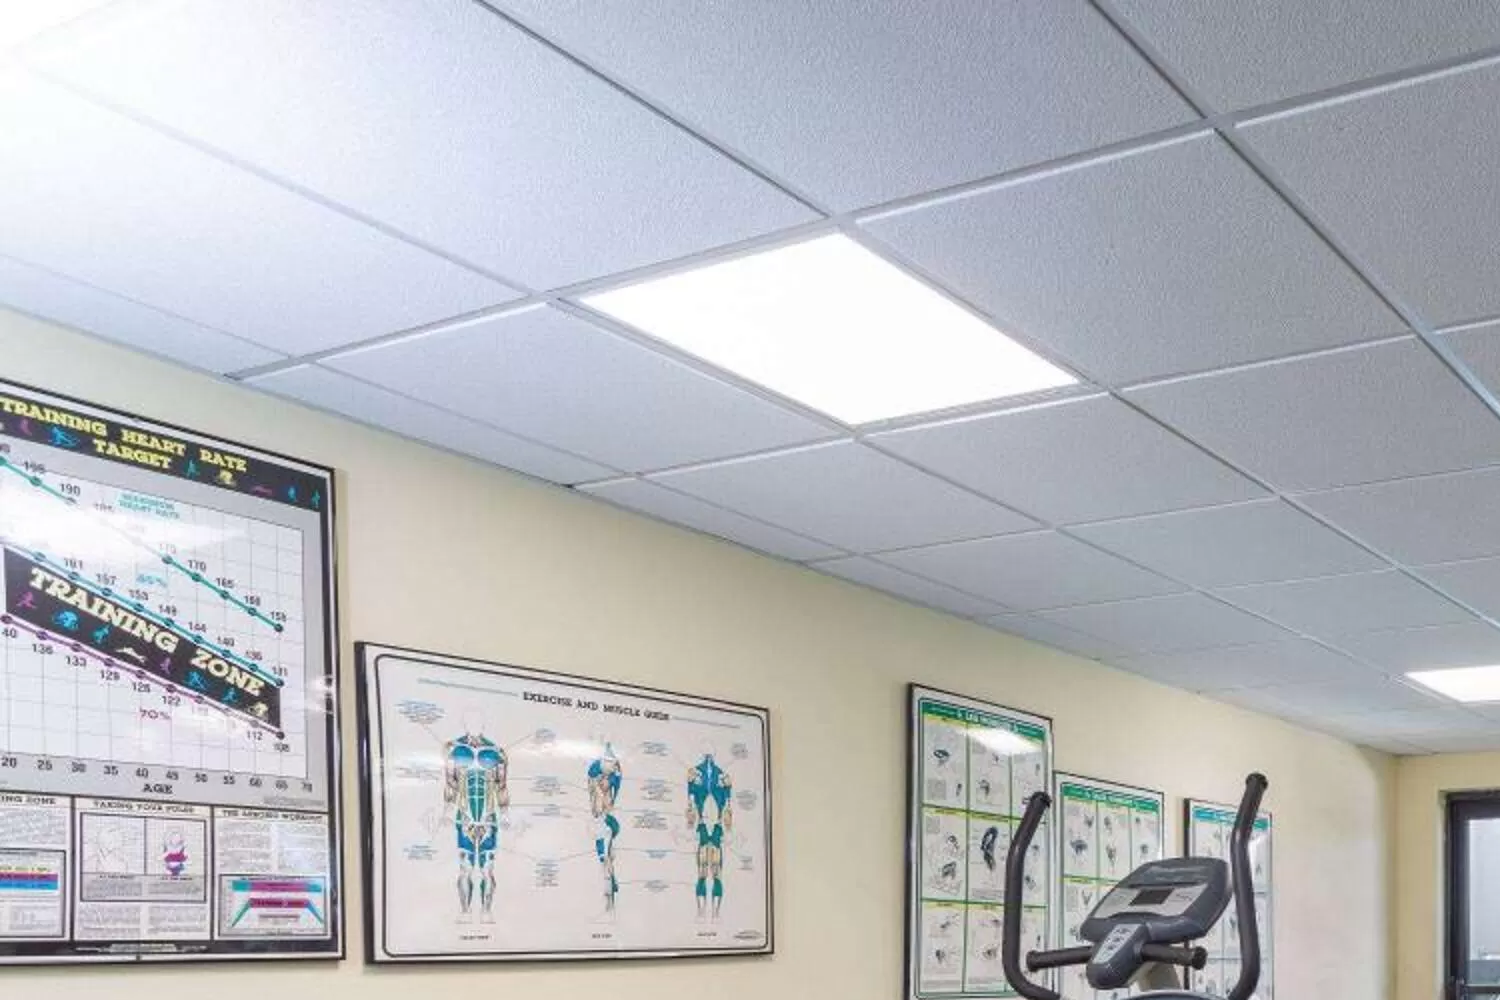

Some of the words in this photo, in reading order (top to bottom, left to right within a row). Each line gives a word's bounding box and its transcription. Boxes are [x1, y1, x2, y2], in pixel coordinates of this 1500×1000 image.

[2, 399, 107, 437] TRAINING
[120, 428, 187, 456] HEART
[199, 449, 248, 473] RATE
[92, 437, 173, 469] TARGET
[59, 482, 82, 497] 190
[29, 566, 180, 653] TRAINING
[190, 647, 266, 697] ZONE
[161, 695, 181, 706] 122
[523, 691, 573, 707] EXERCISE
[577, 698, 599, 711] AND
[603, 703, 641, 717] MUSCLE
[1, 756, 18, 769] 20
[36, 758, 53, 771] 25
[71, 760, 87, 773] 30
[103, 764, 119, 776] 35
[135, 766, 150, 778] 40
[165, 769, 180, 781] 45
[142, 783, 174, 795] AGE
